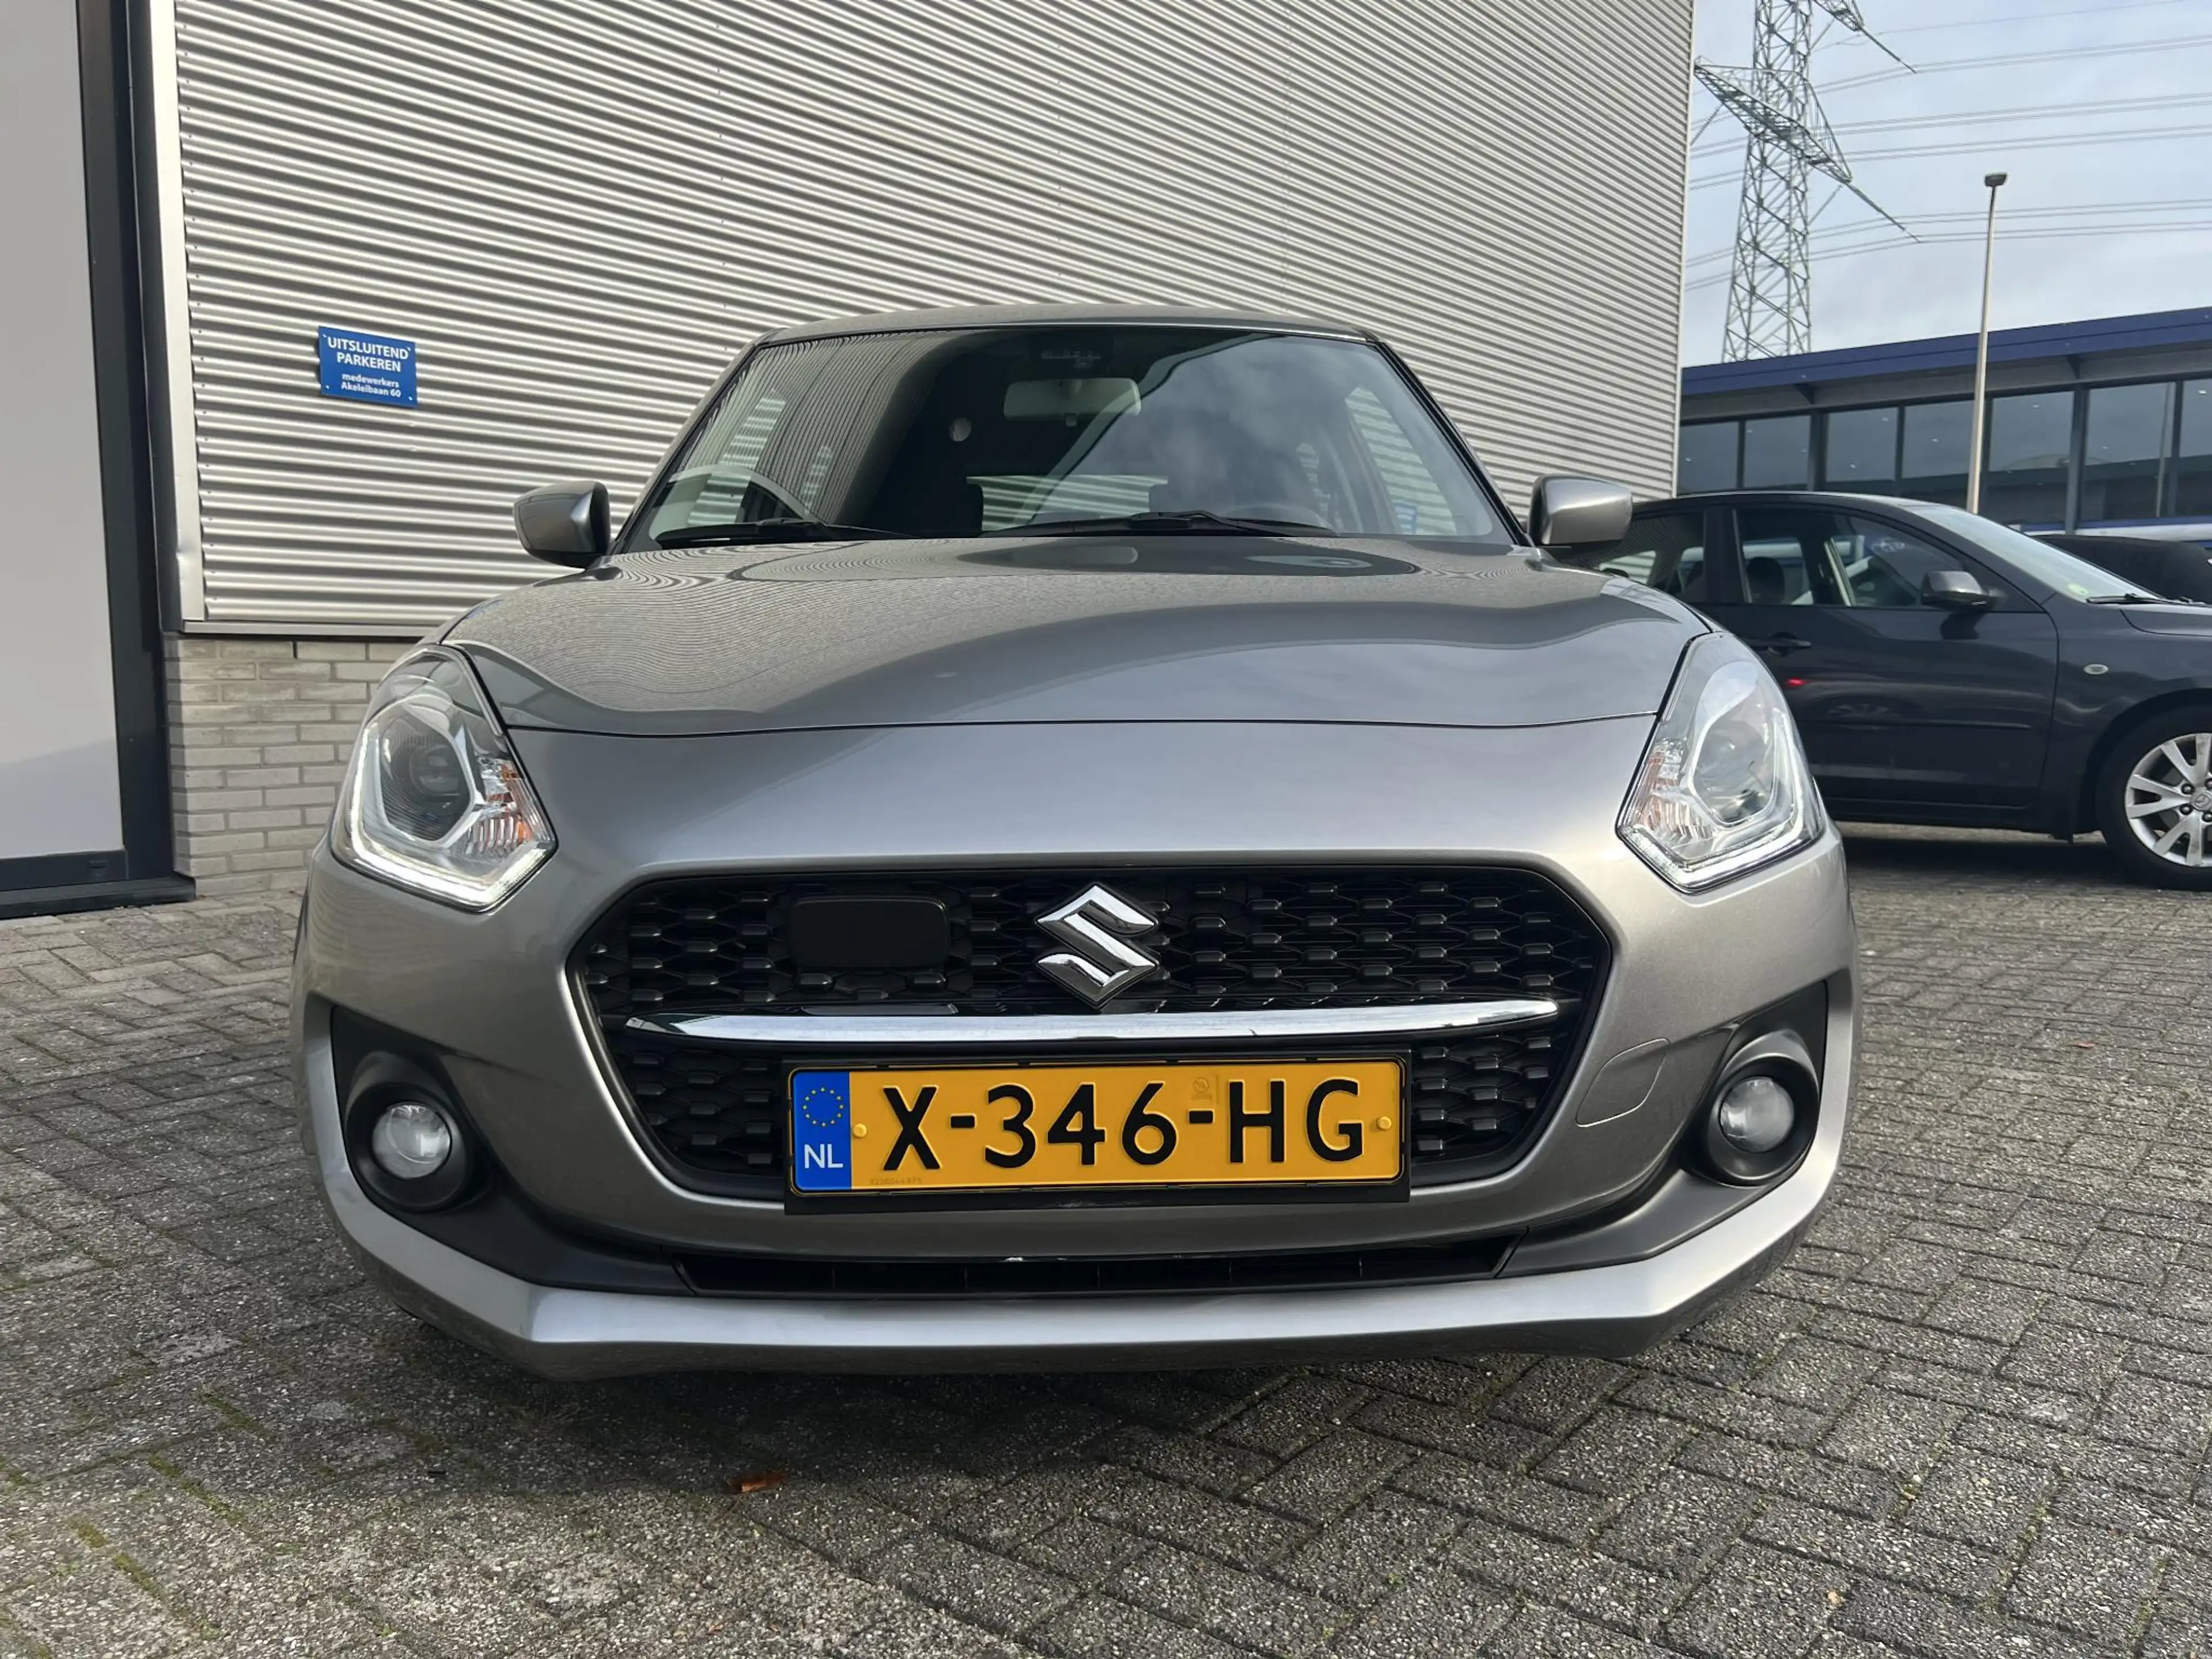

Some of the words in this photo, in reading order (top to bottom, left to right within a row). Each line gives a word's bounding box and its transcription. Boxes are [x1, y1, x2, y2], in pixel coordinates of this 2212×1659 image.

[328, 336, 408, 359] UITSLUITEND
[337, 352, 401, 372] PARKEREN
[341, 381, 388, 396] Akeleibaan
[390, 389, 401, 397] 60
[342, 373, 399, 388] medewerkers
[883, 1079, 1363, 1171] X-346-HG
[804, 1143, 843, 1169] NL
